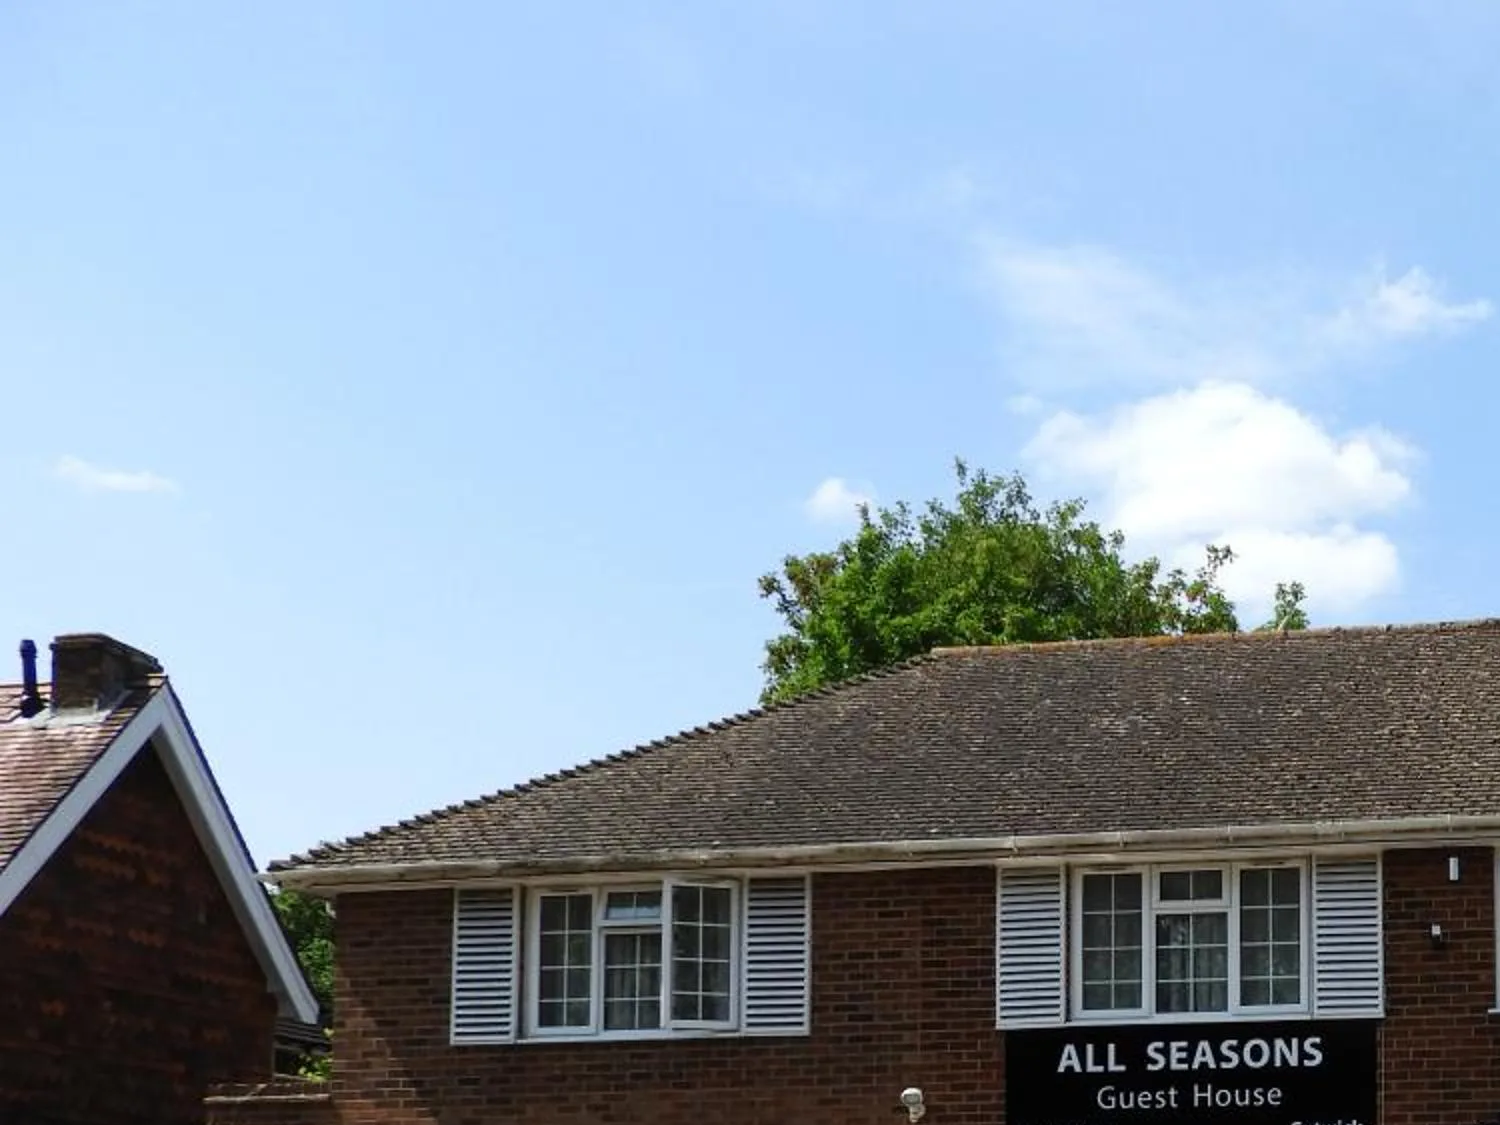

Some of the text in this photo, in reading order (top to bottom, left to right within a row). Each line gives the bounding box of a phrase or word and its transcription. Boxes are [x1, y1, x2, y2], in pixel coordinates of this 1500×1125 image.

[1056, 1036, 1323, 1073] ALL SEASONS
[1097, 1083, 1283, 1110] Guest House
